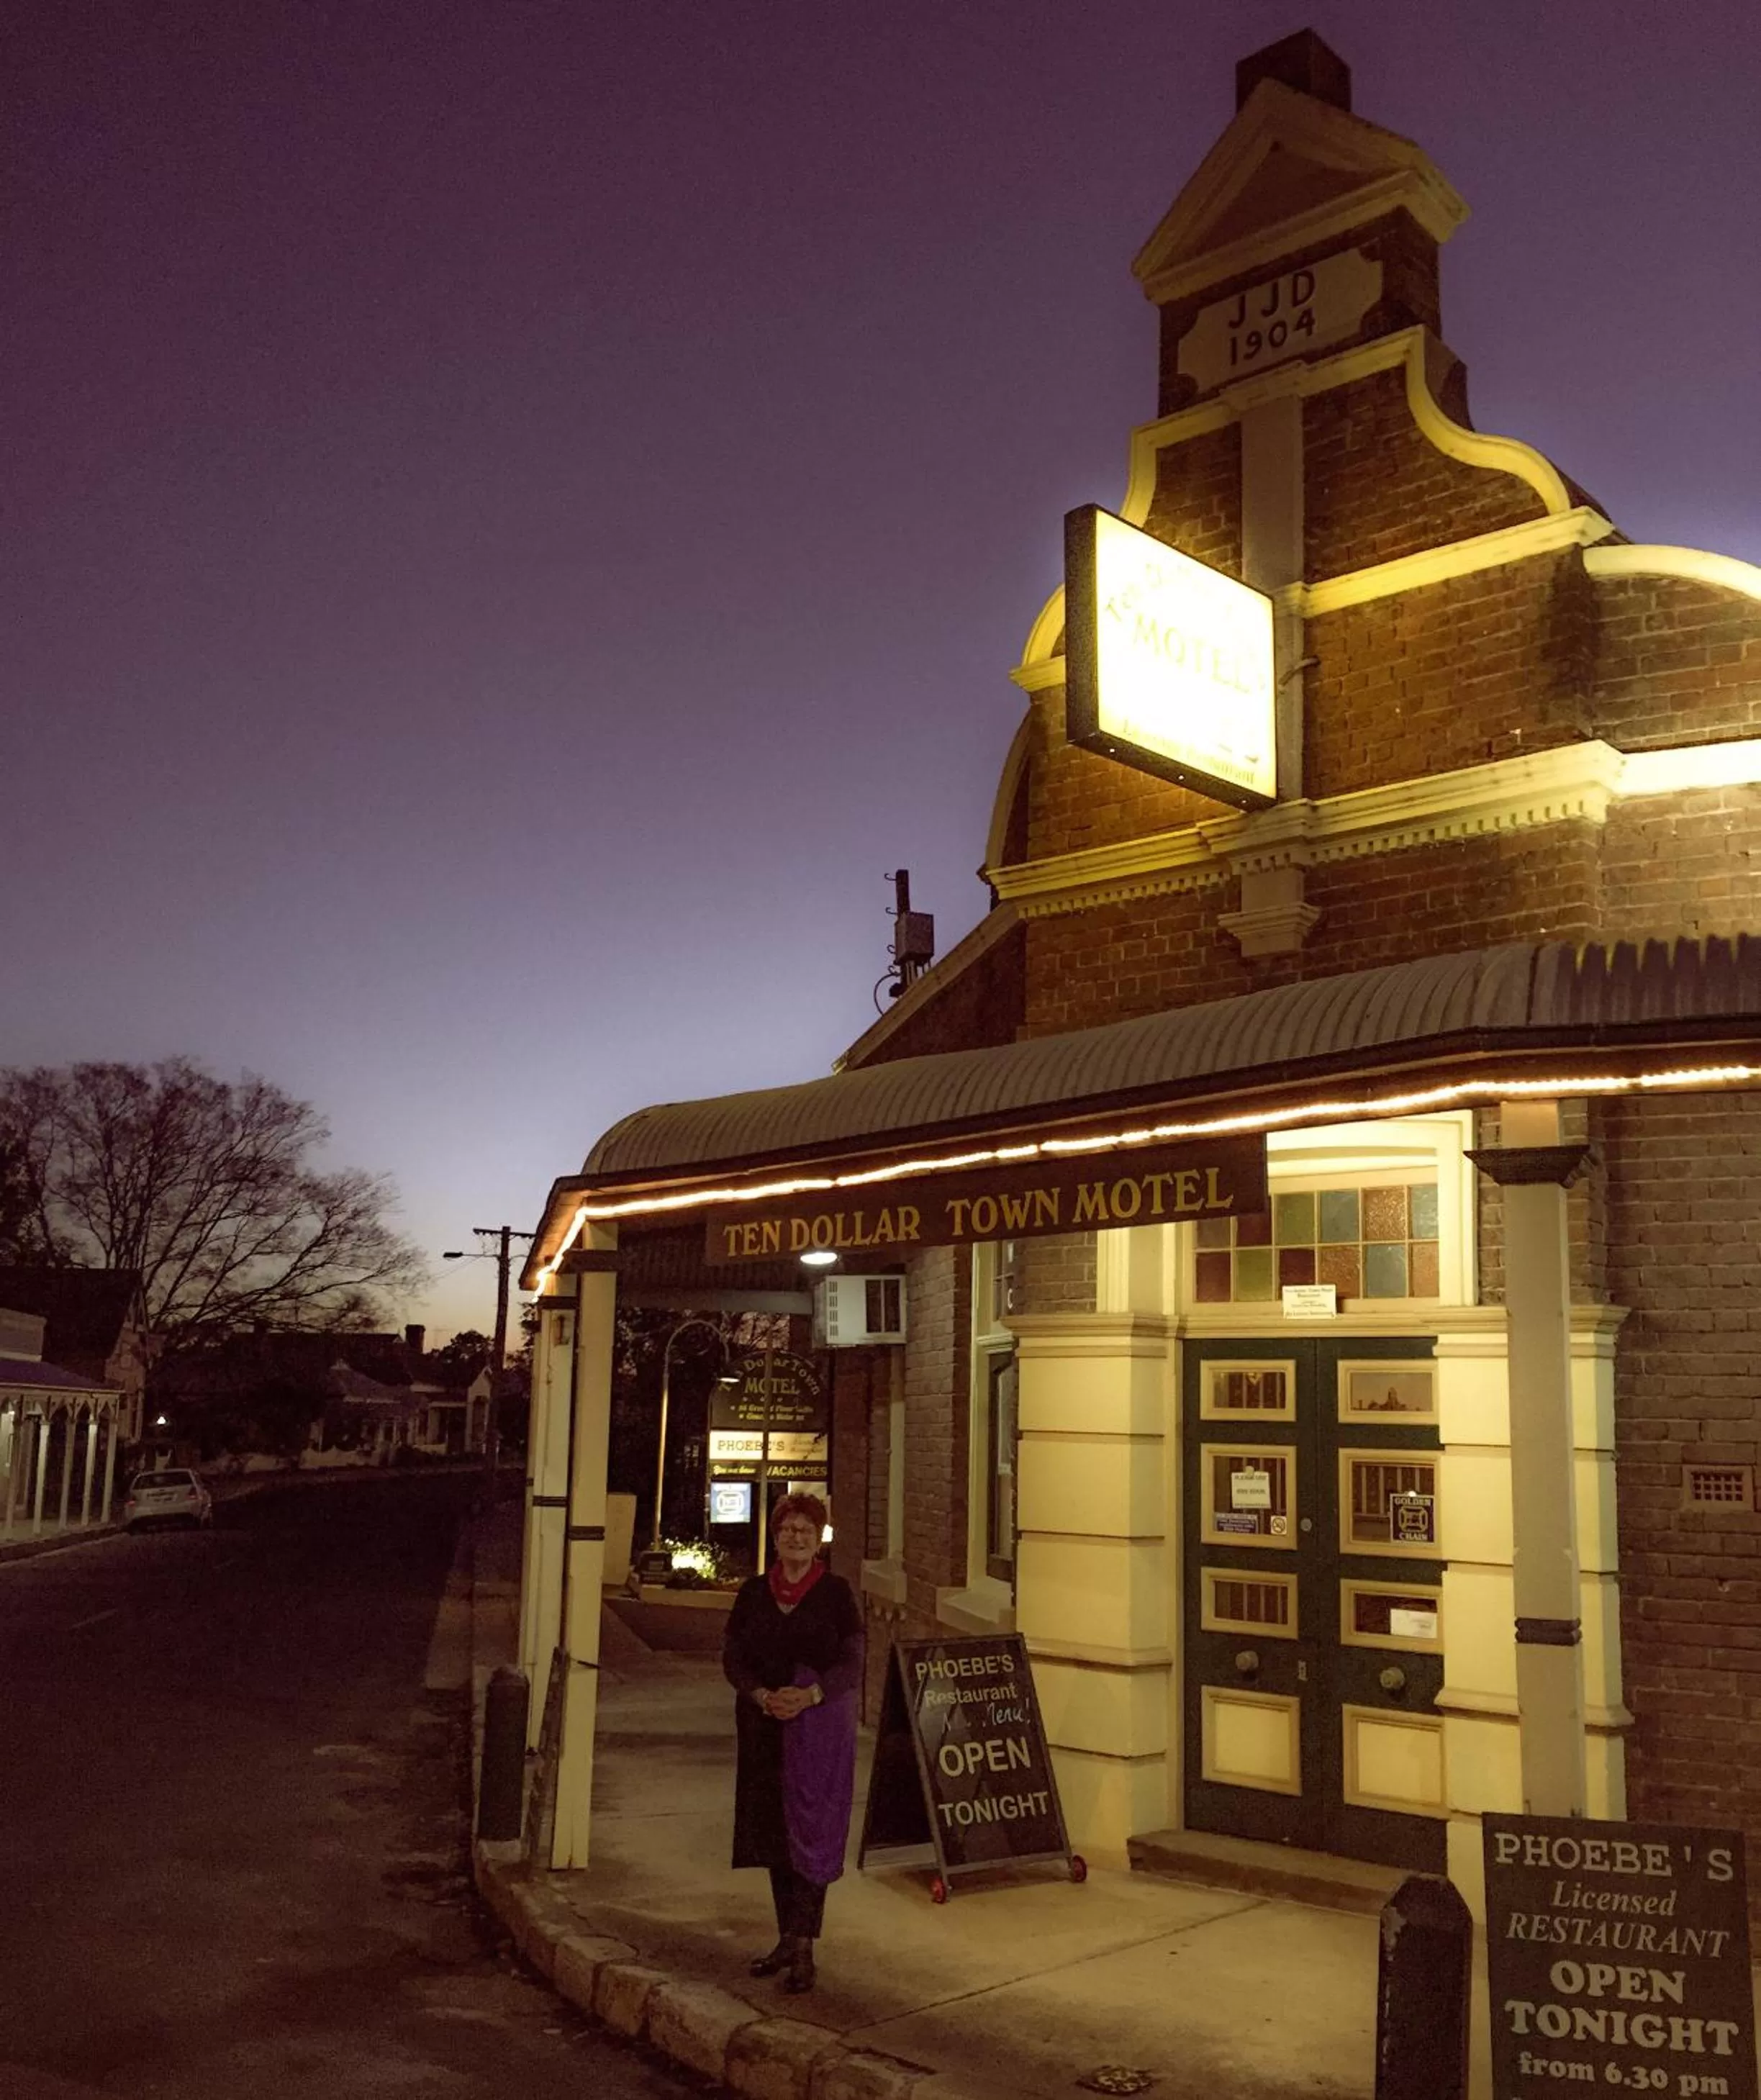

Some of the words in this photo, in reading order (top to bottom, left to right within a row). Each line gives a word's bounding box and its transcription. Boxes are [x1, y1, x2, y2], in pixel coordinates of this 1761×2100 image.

[1230, 308, 1316, 365] 1904
[1133, 612, 1251, 694] MOTEL
[724, 1222, 780, 1257] TEN
[790, 1205, 920, 1252] DOLLAR
[946, 1187, 1061, 1236] TOWN
[1072, 1167, 1233, 1223] MOTEL
[1395, 1498, 1431, 1506] GOLDEN
[915, 1655, 1015, 1681] PHOEBE'S
[924, 1683, 1018, 1707] Restaurant
[939, 1737, 1031, 1777] OPEN
[938, 1791, 1048, 1828] TONIGHT
[1549, 1881, 1678, 1916] Licensed
[1506, 1913, 1730, 1958] RESTAURANT
[1549, 1960, 1686, 2004] OPEN
[1504, 2000, 1739, 2055] TONIGHT
[1519, 2051, 1595, 2083] from
[1605, 2062, 1669, 2090] 6.30
[1678, 2073, 1729, 2097] pm
